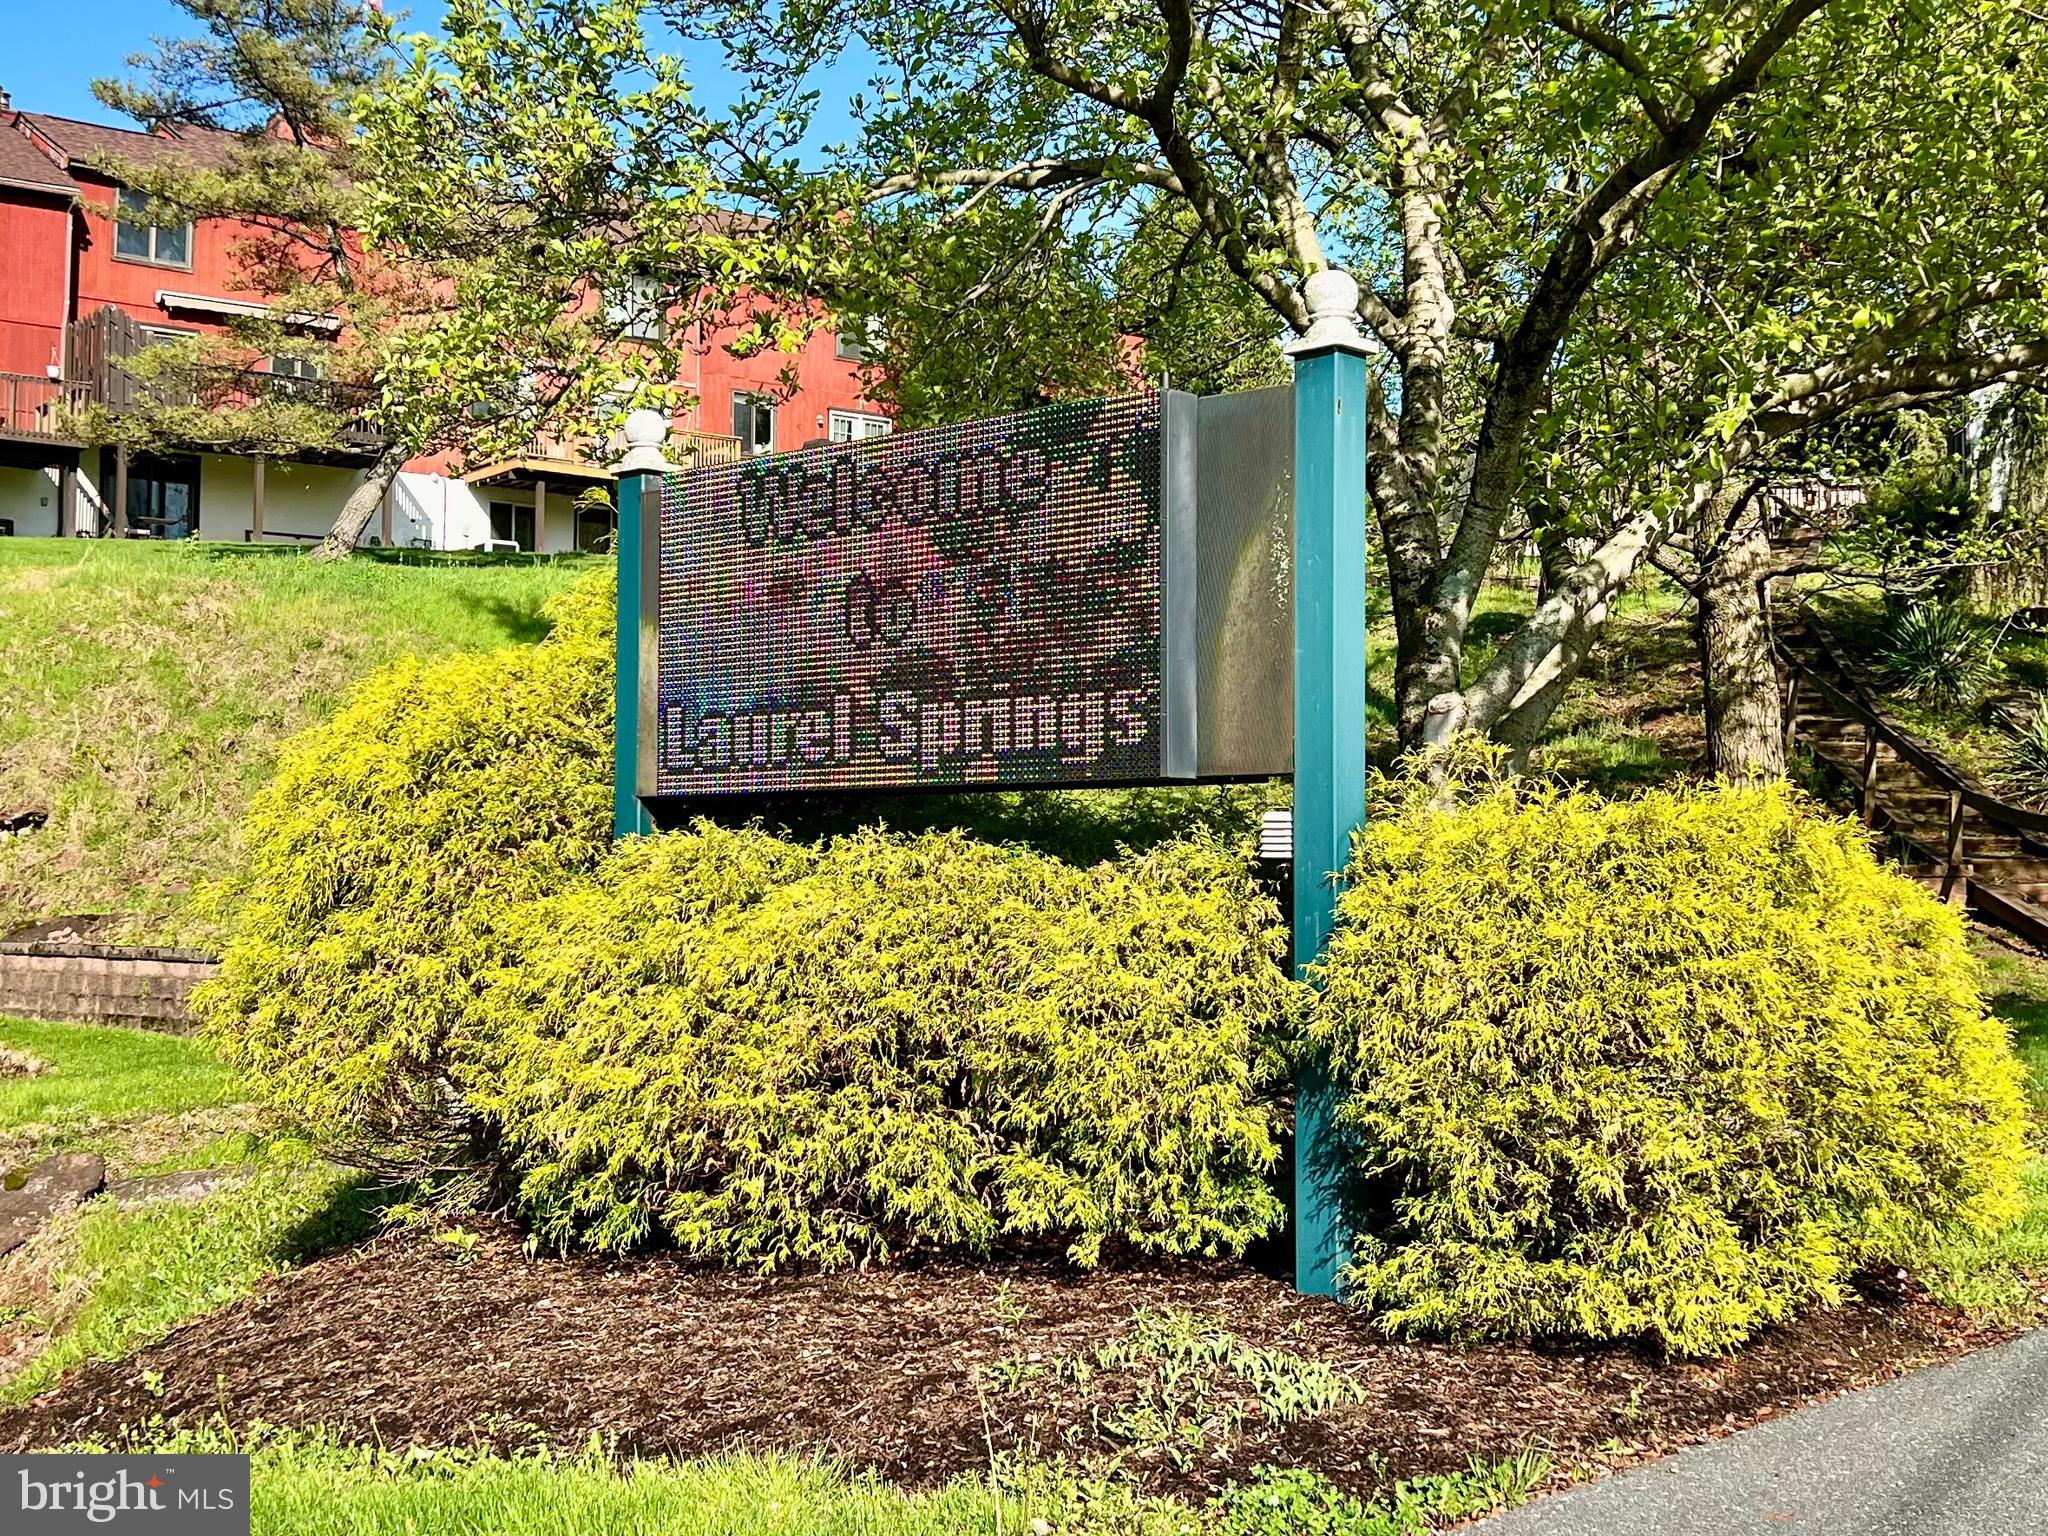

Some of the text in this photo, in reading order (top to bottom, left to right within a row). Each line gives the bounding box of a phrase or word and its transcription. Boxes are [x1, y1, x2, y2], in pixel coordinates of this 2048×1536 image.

[739, 447, 1049, 544] Welcome
[665, 690, 1149, 770] Laurel Springs
